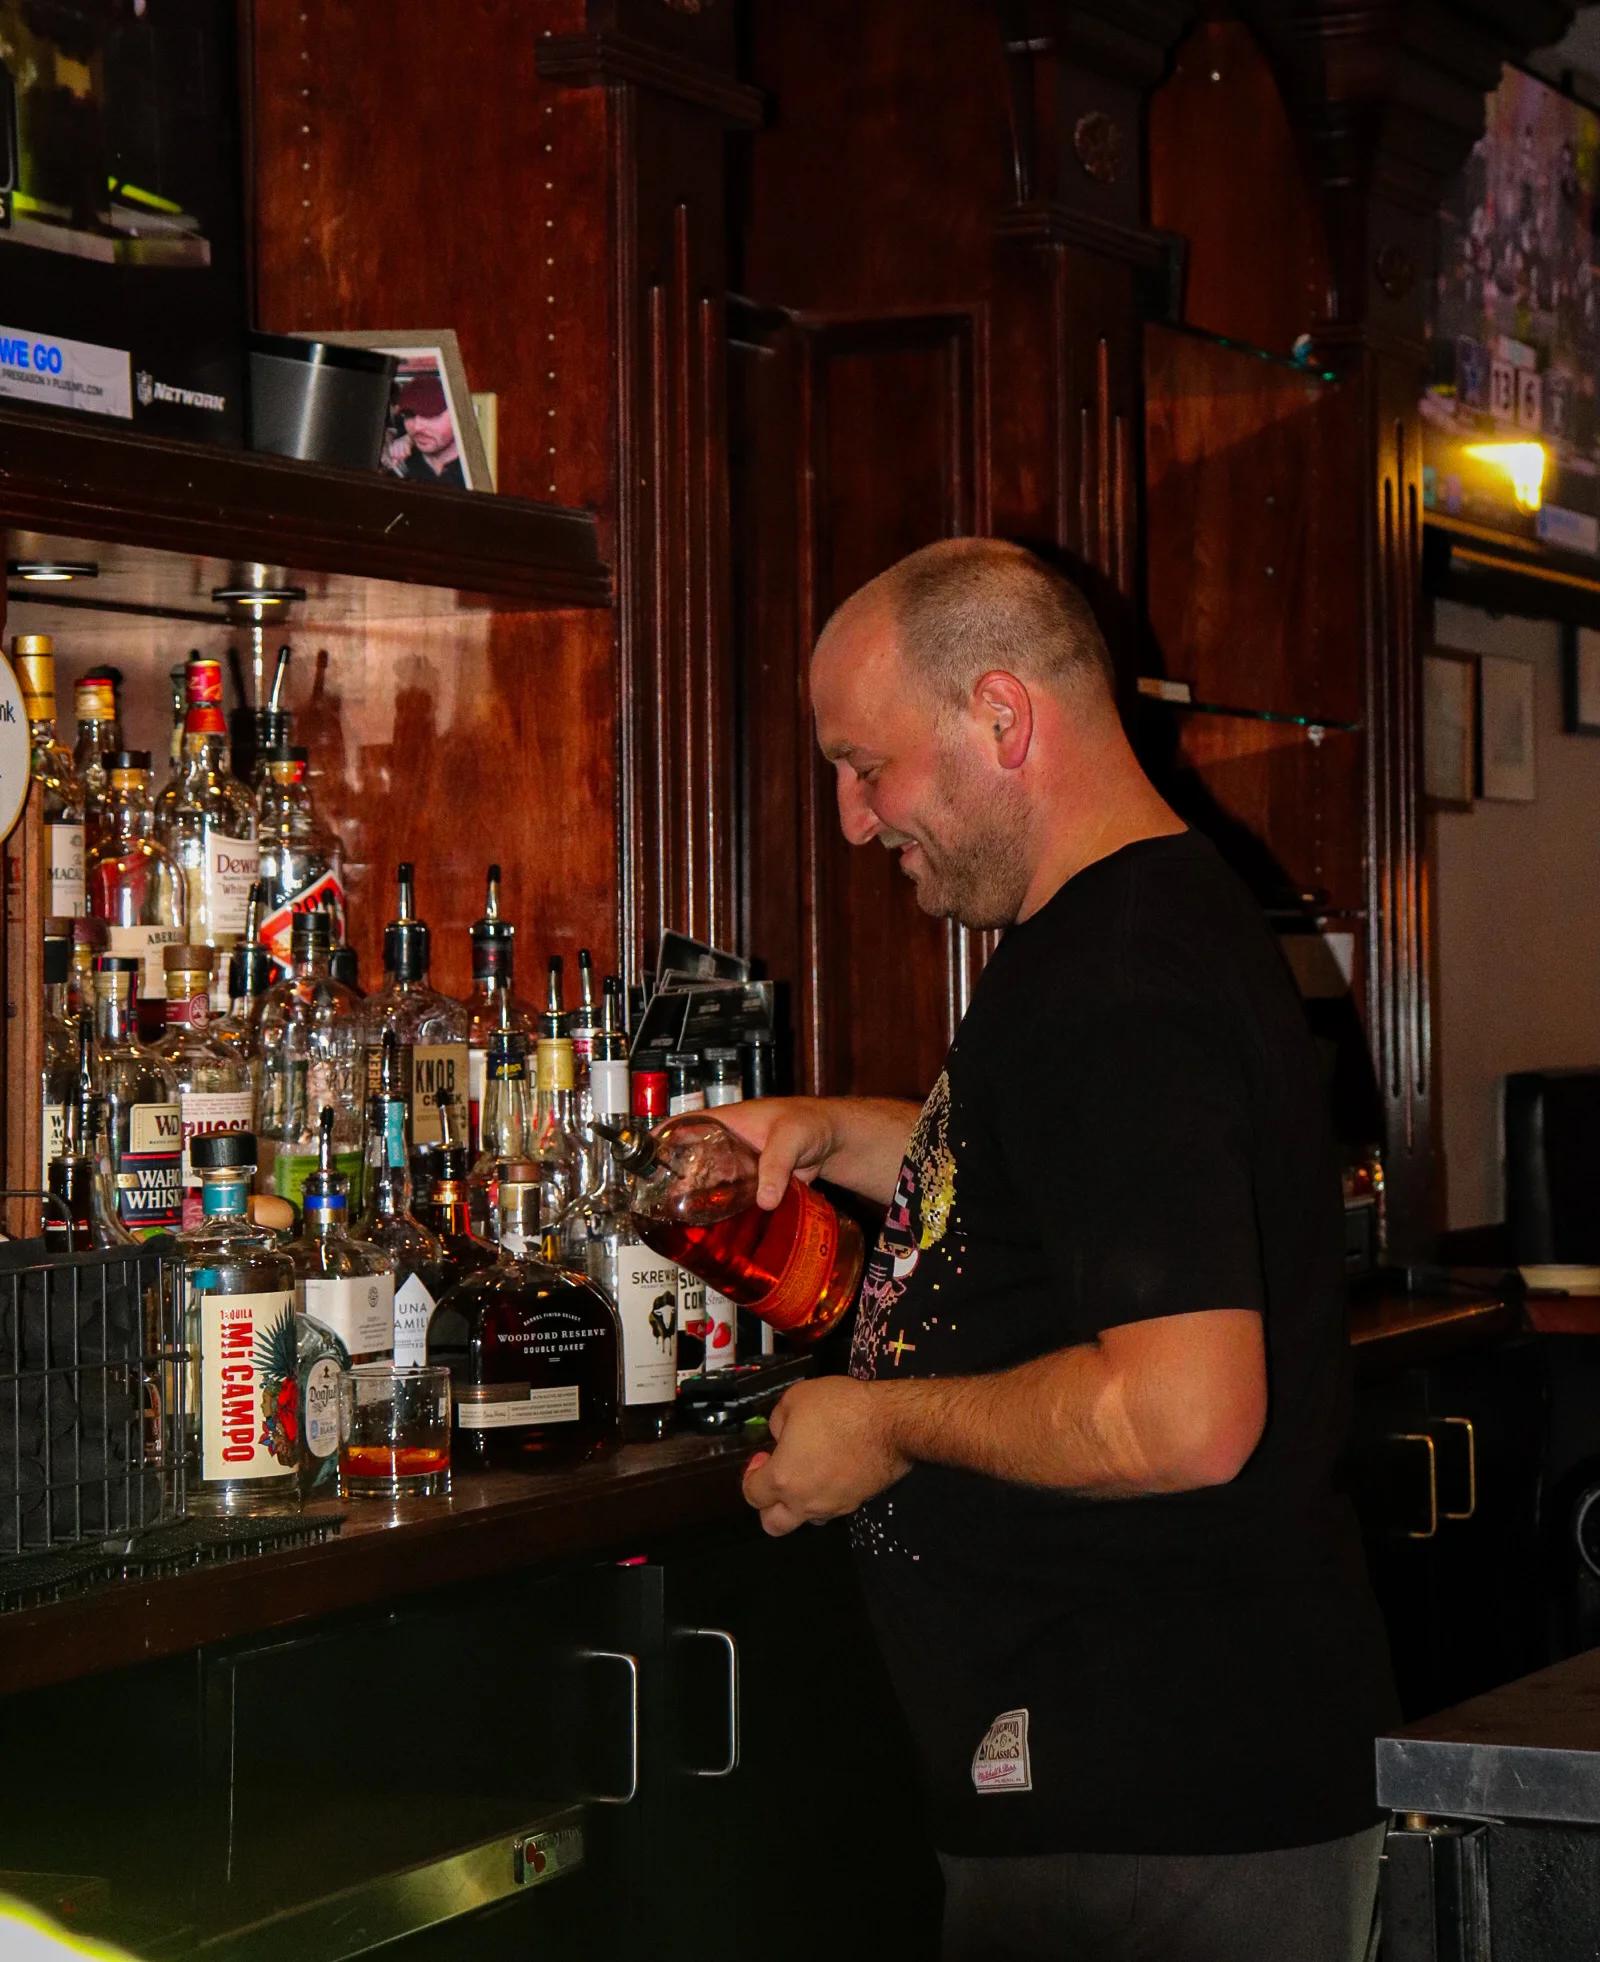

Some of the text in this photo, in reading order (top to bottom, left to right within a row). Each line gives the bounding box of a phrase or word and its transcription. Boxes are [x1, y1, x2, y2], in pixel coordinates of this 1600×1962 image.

[0, 338, 62, 374] WE GO
[416, 1060, 455, 1092] KNOB
[399, 1302, 428, 1315] UNA
[497, 1328, 605, 1343] WOODFORD RESERVE
[523, 1342, 585, 1354] DOUBLE OAKED
